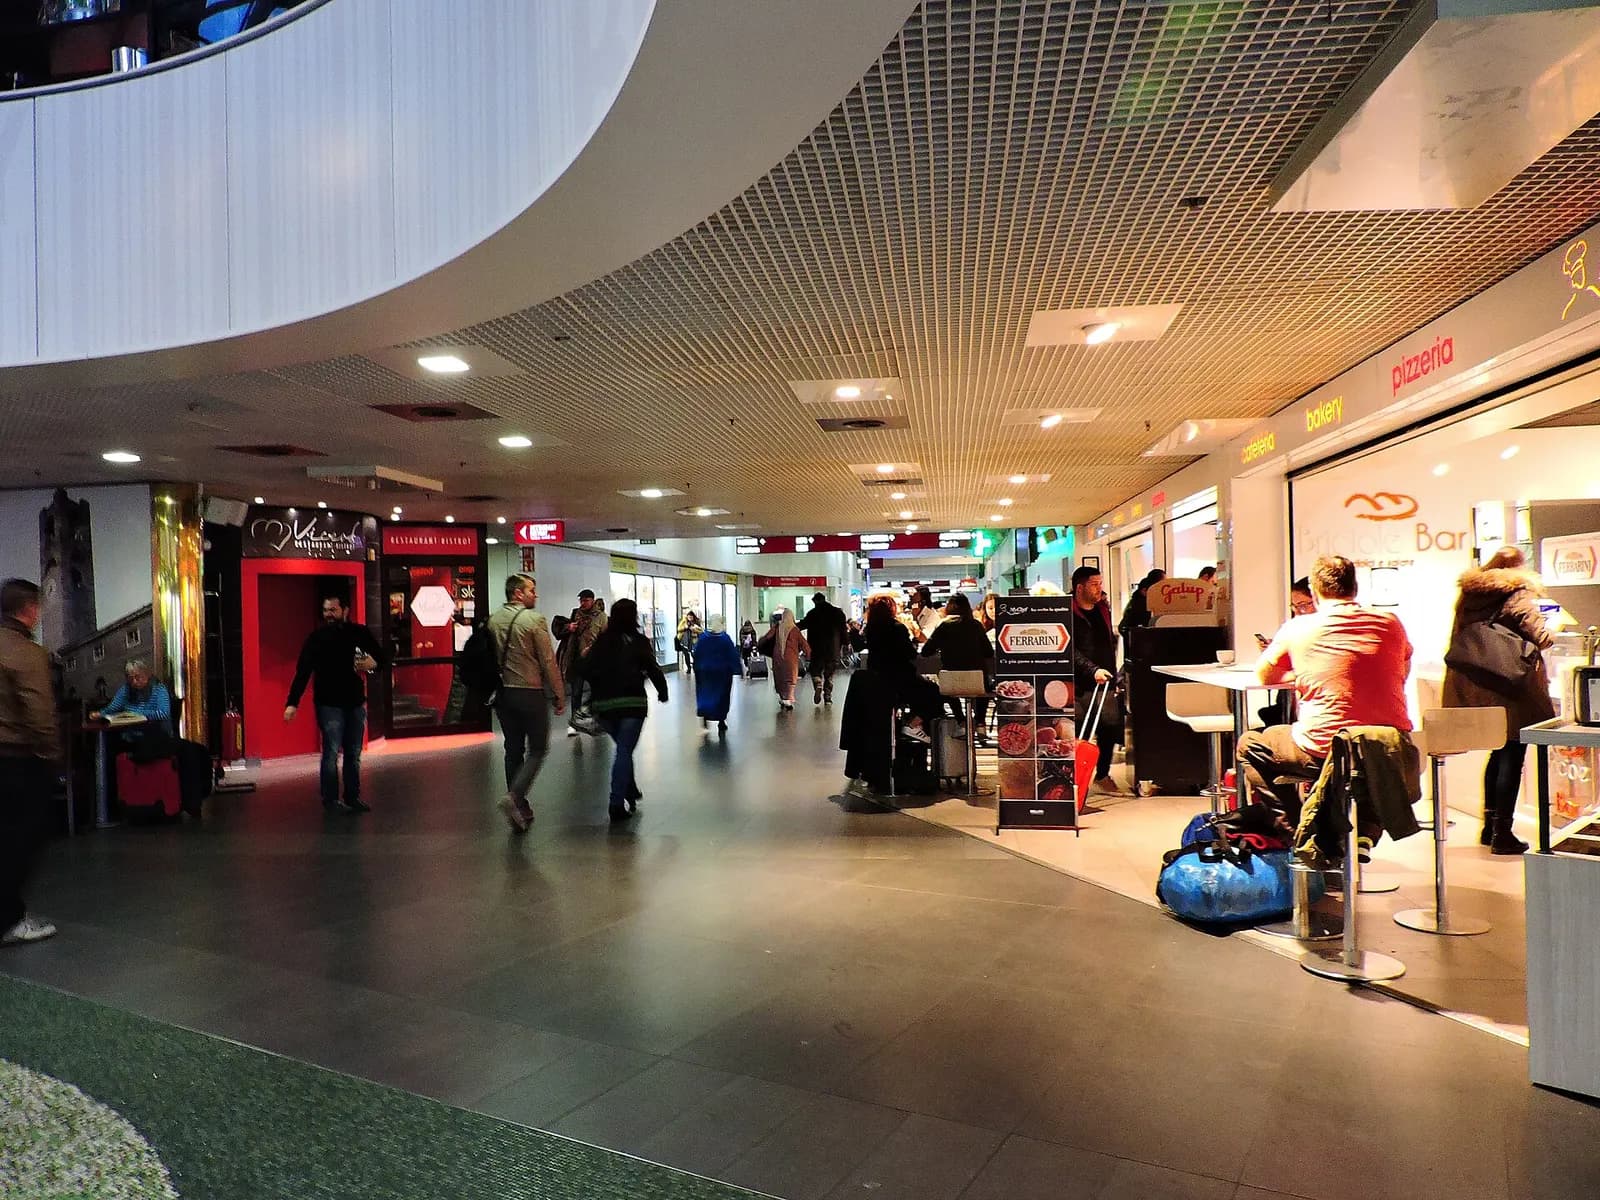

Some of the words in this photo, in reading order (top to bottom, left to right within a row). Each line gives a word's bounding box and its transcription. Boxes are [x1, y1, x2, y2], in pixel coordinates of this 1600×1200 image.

[1392, 336, 1453, 397] pizzeria
[1306, 395, 1343, 432] bakery
[391, 535, 437, 545] RESTAURANT
[441, 536, 471, 545] BISTROT
[1416, 523, 1467, 551] Bar
[1161, 582, 1204, 605] Galup
[1009, 635, 1059, 646] FERRARINI
